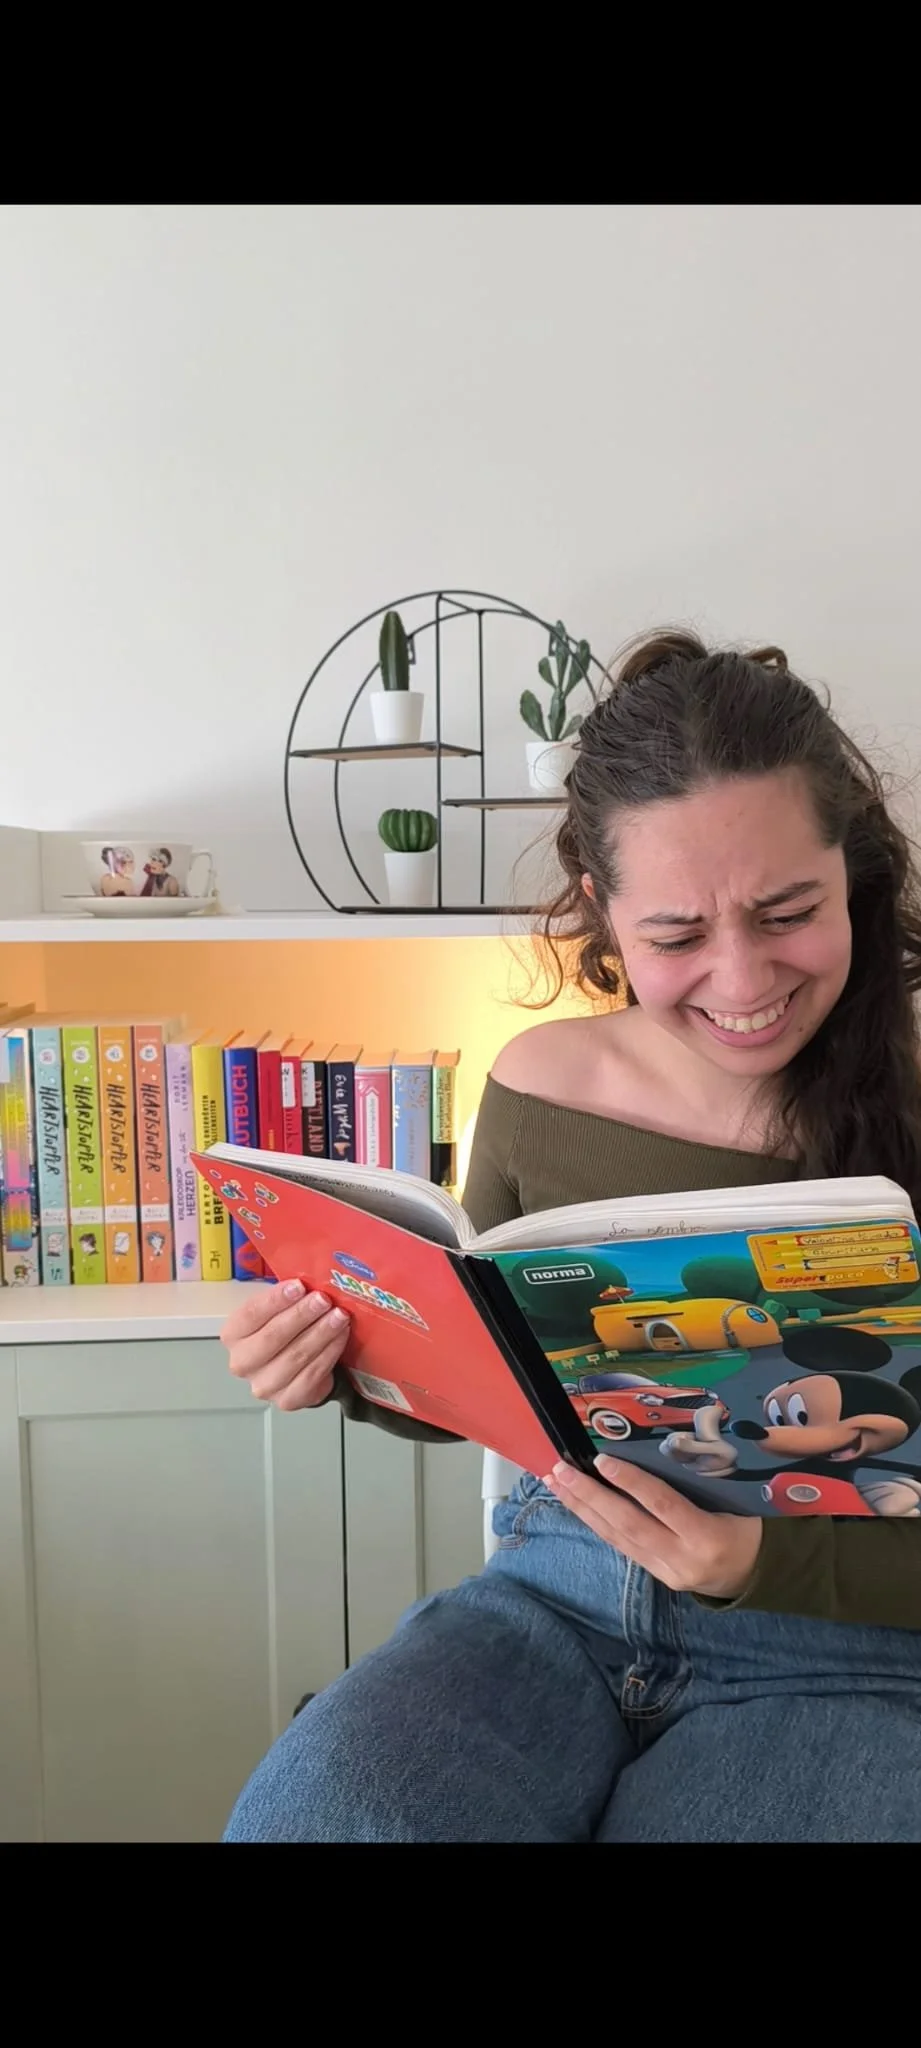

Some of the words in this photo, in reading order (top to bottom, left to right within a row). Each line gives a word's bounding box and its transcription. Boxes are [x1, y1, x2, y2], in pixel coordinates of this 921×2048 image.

[38, 1085, 61, 1176] HEARTSTOPPER
[72, 1084, 94, 1174] HEARTSTOPPER
[106, 1082, 127, 1174] HEARTSTOPPER
[140, 1082, 162, 1173] HEARTSTOPPER
[231, 1065, 249, 1149] UTBUCH
[332, 1104, 353, 1140] Wyld
[185, 1170, 196, 1217] HERZEN
[203, 1183, 212, 1225] BERTO
[212, 1186, 224, 1225] BRE
[531, 1267, 586, 1280] norma
